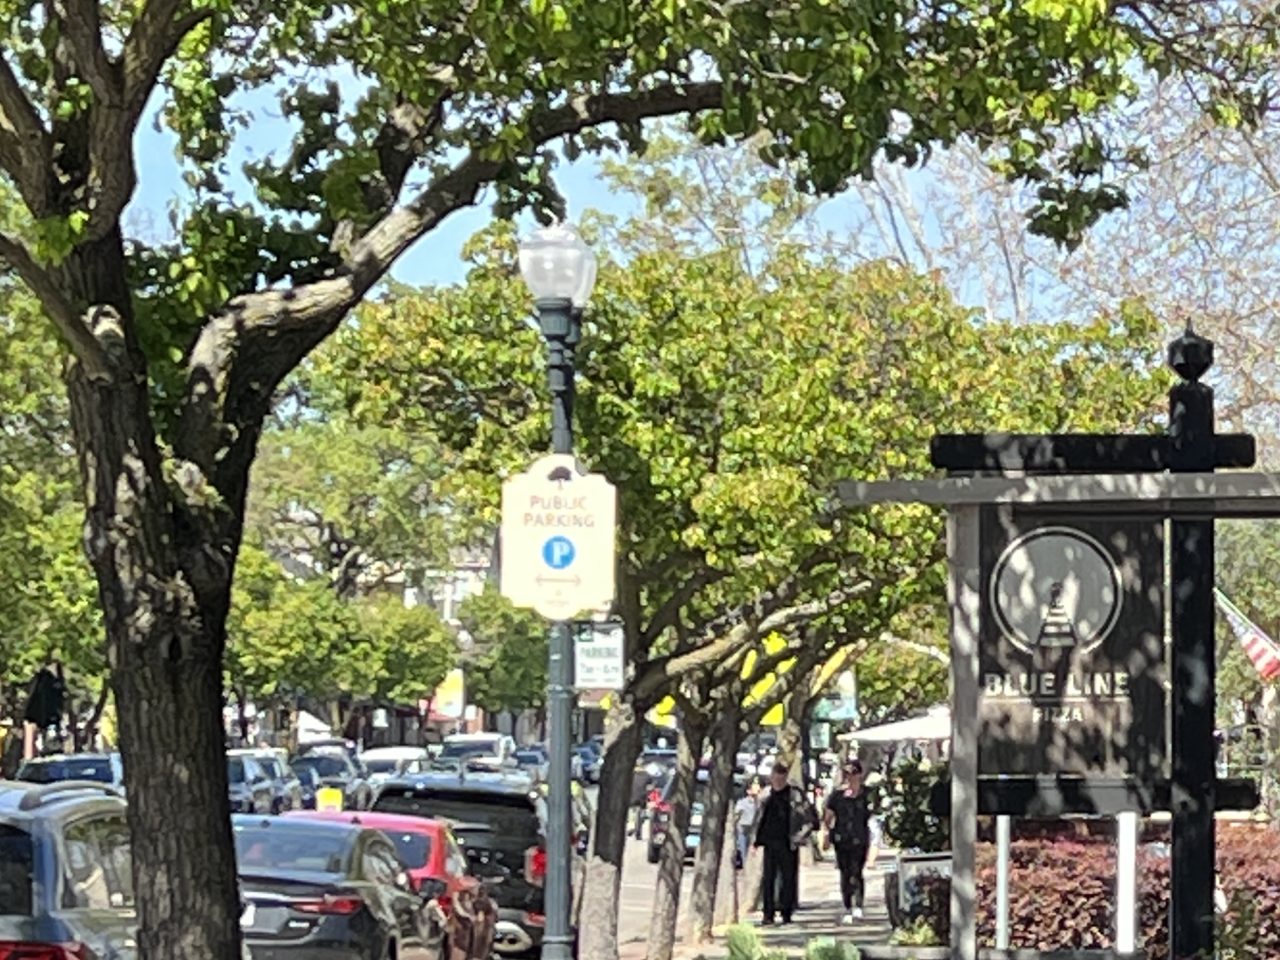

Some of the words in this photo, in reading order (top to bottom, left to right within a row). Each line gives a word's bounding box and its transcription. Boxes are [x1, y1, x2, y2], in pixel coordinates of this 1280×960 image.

[529, 495, 587, 510] PUBLIC
[523, 512, 595, 528] PARKING
[552, 540, 571, 567] P
[984, 672, 1056, 696] BLUE
[1066, 672, 1130, 695] LINE
[1032, 706, 1083, 723] PIZZA
